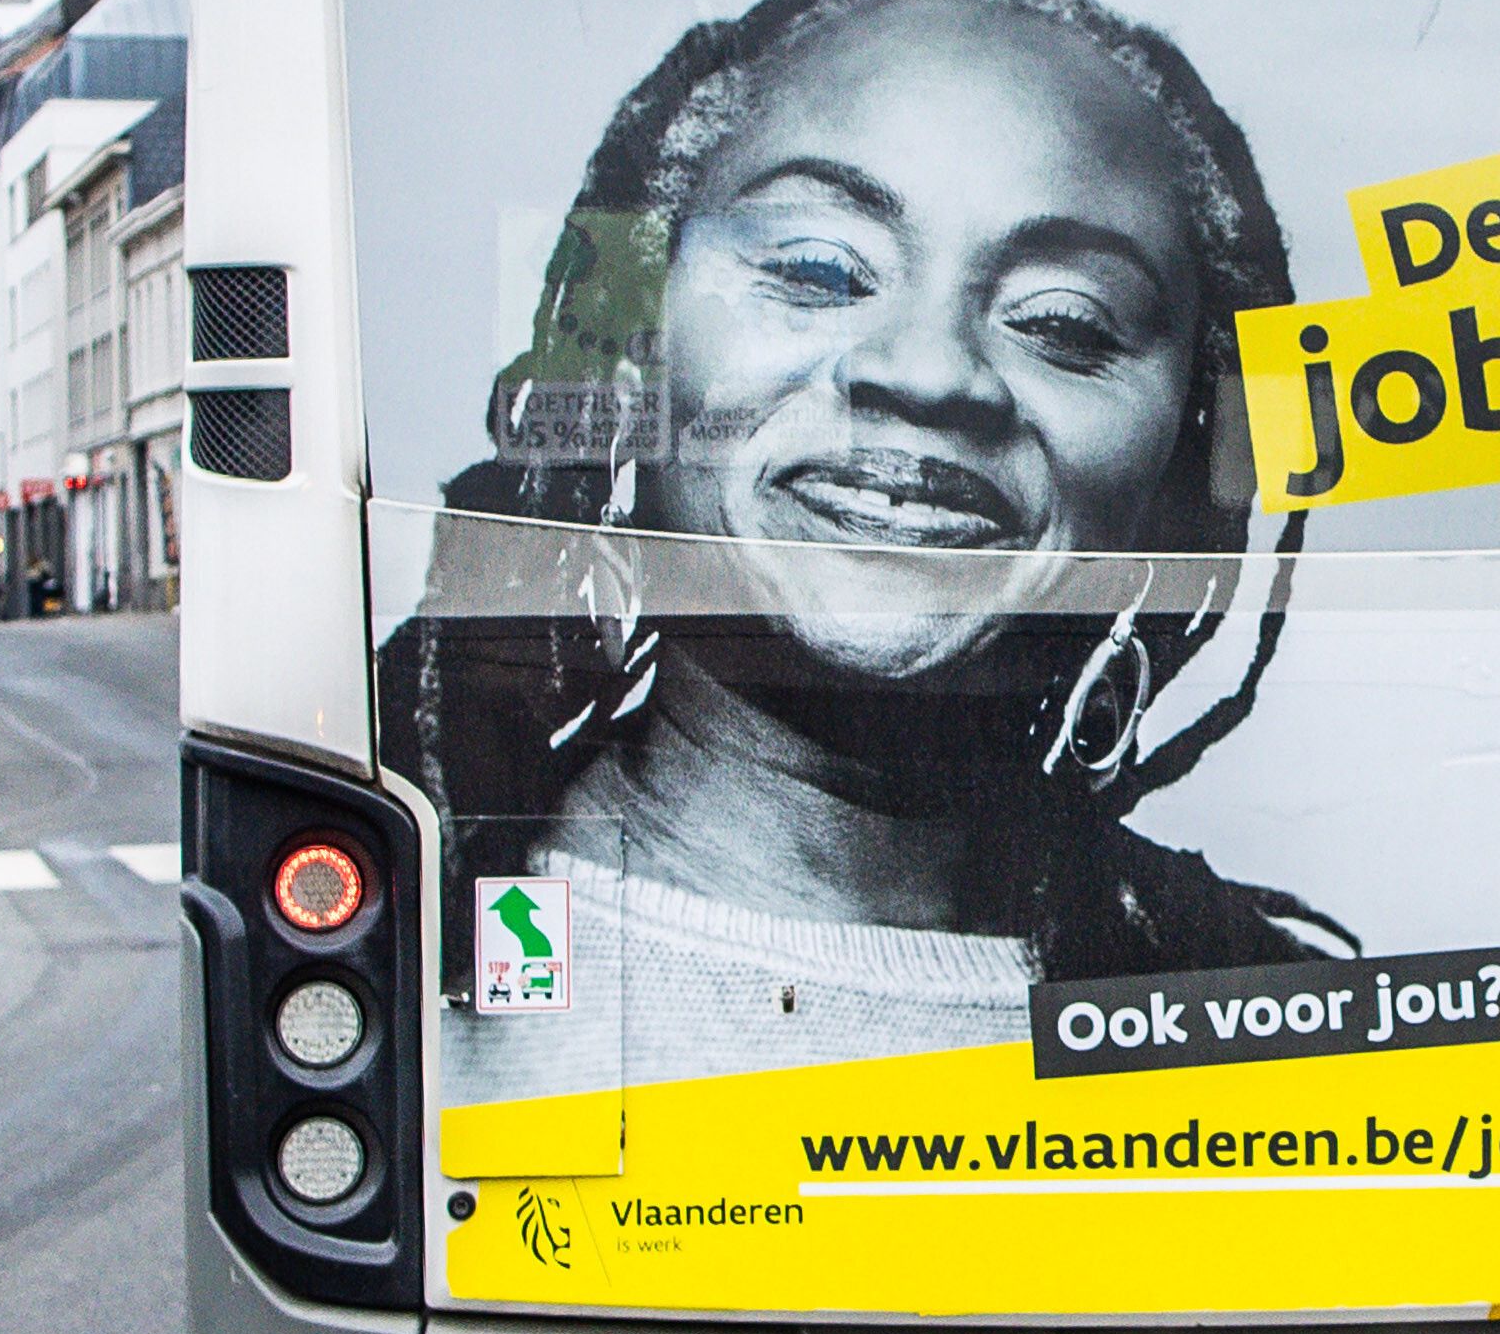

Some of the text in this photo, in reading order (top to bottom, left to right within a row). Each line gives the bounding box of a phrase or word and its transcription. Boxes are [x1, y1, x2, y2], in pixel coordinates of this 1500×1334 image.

[1056, 992, 1188, 1052] Ook
[1203, 989, 1353, 1041] voor
[610, 1197, 804, 1227] Vlaanderen
[616, 1236, 682, 1252] is werk
